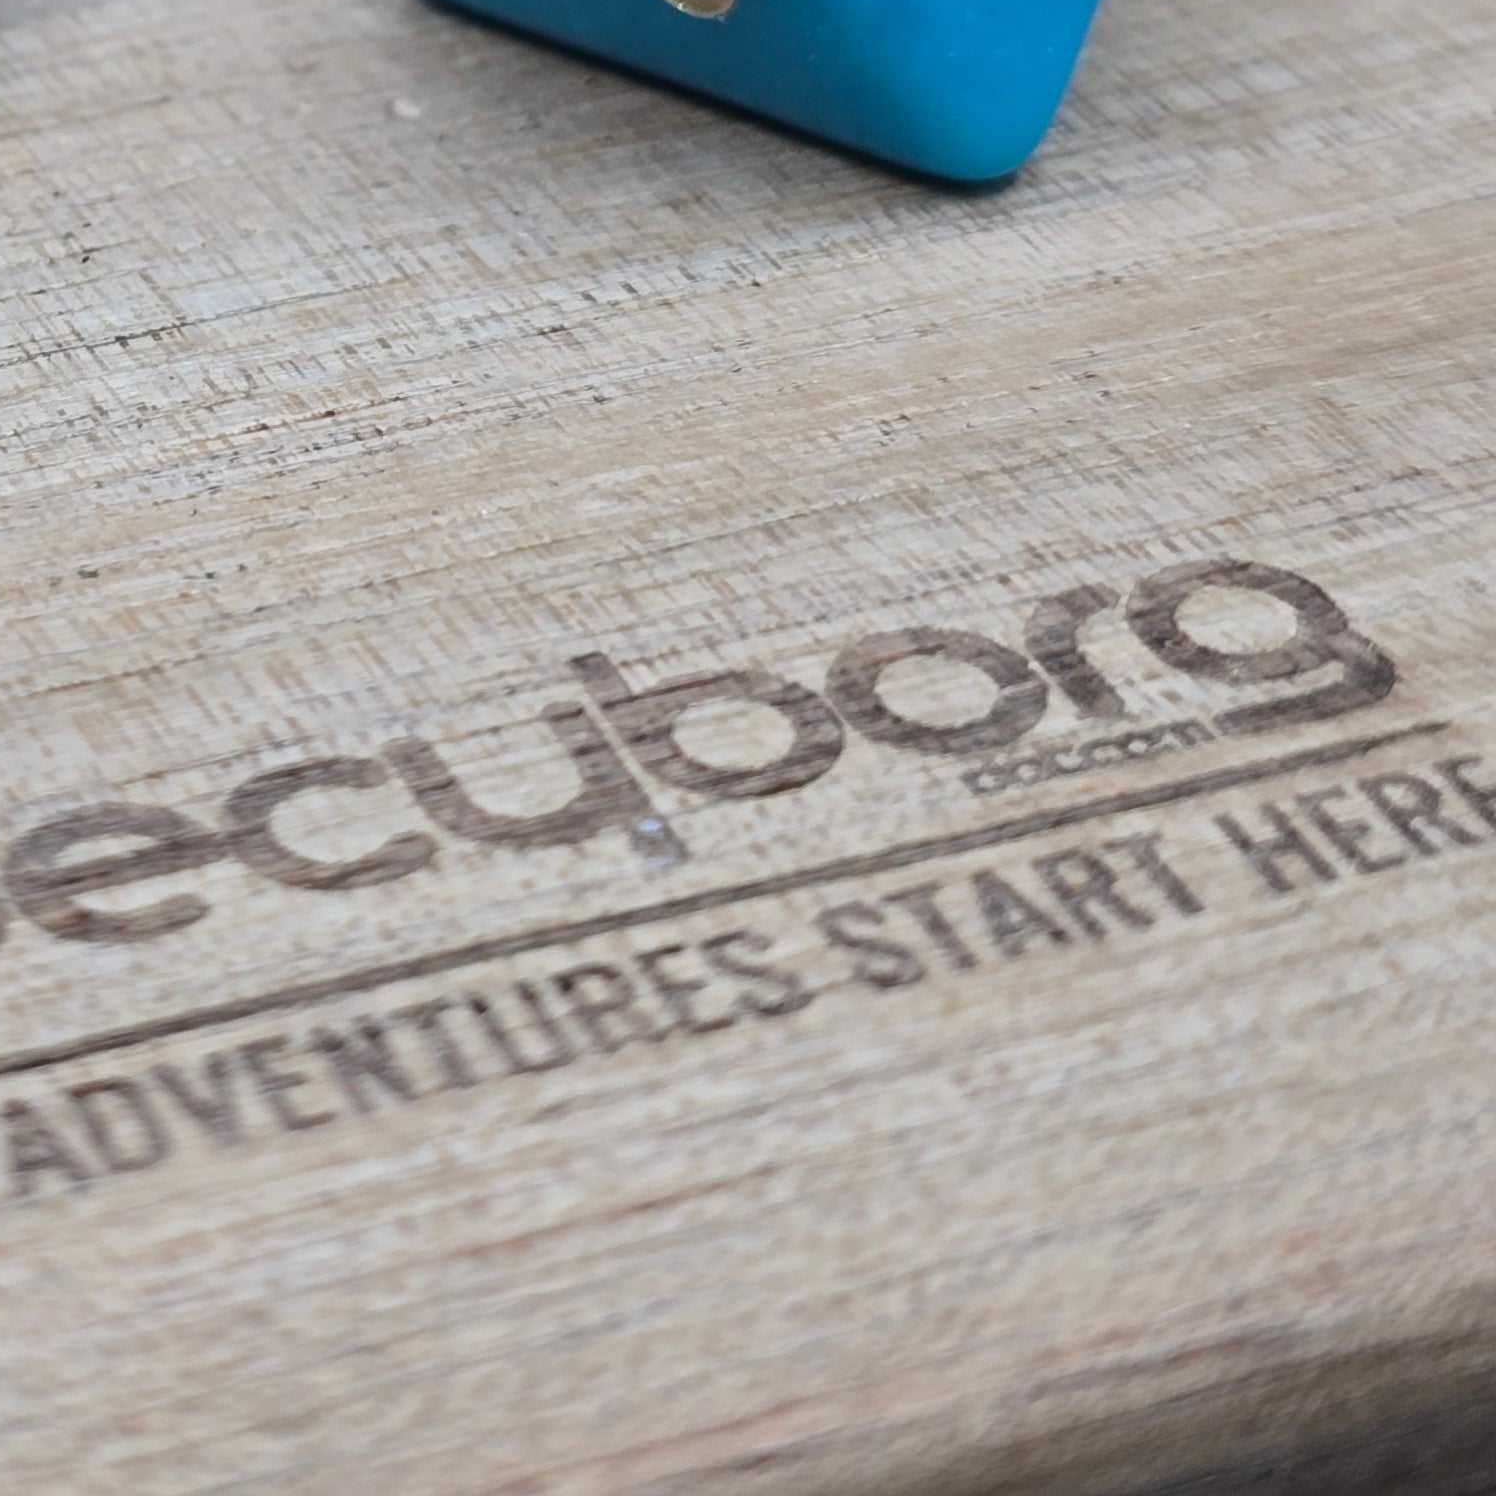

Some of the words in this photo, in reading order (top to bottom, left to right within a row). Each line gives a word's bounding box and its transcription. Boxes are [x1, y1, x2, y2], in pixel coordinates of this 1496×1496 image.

[0, 928, 818, 1204] ADVENTURES
[812, 830, 1207, 992] START
[1210, 754, 1496, 896] HERE
